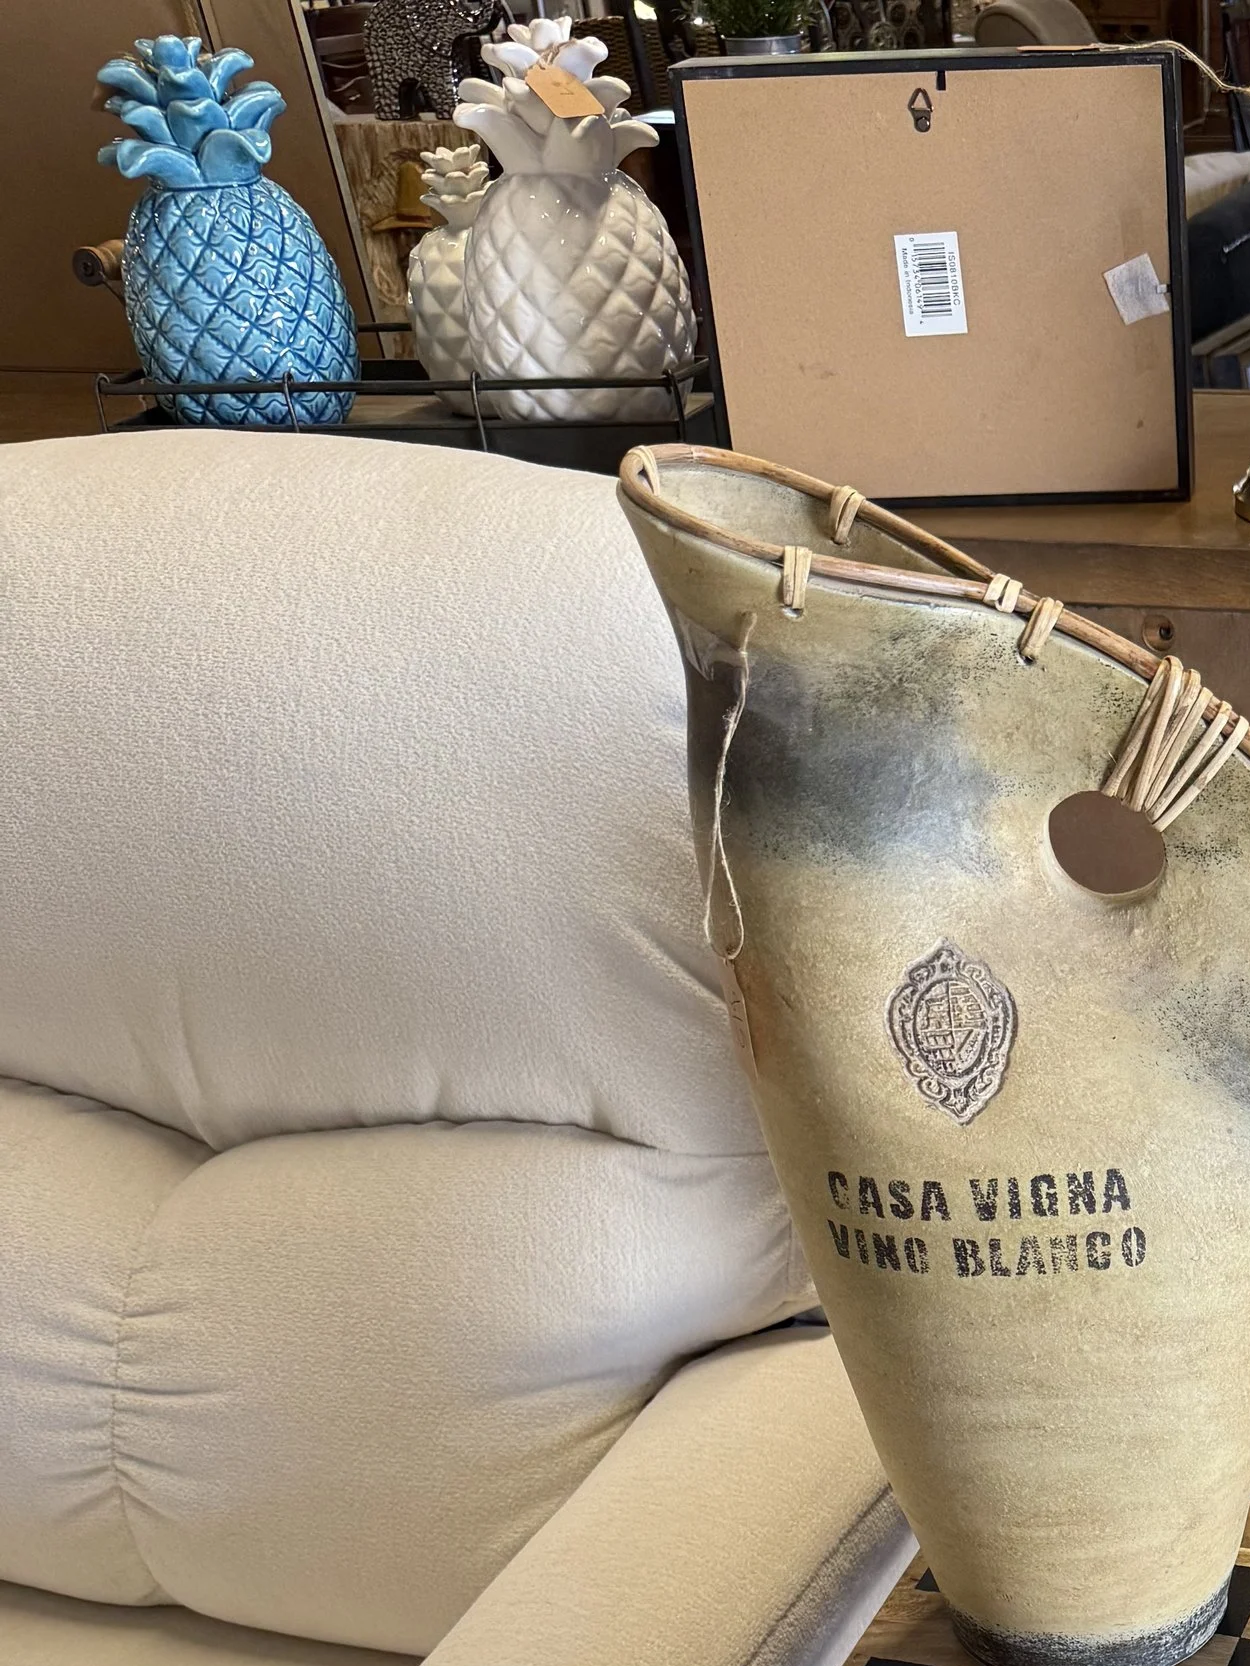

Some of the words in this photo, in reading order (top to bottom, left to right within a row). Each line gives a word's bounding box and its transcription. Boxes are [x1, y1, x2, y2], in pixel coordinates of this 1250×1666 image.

[901, 247, 909, 269] Made
[905, 279, 914, 315] Indonesia
[947, 251, 961, 306] IS0810BKC
[826, 1169, 952, 1222] CASA
[969, 1168, 1133, 1222] VIGNA
[827, 1219, 930, 1274] VINO
[952, 1226, 1148, 1278] BLANCO
